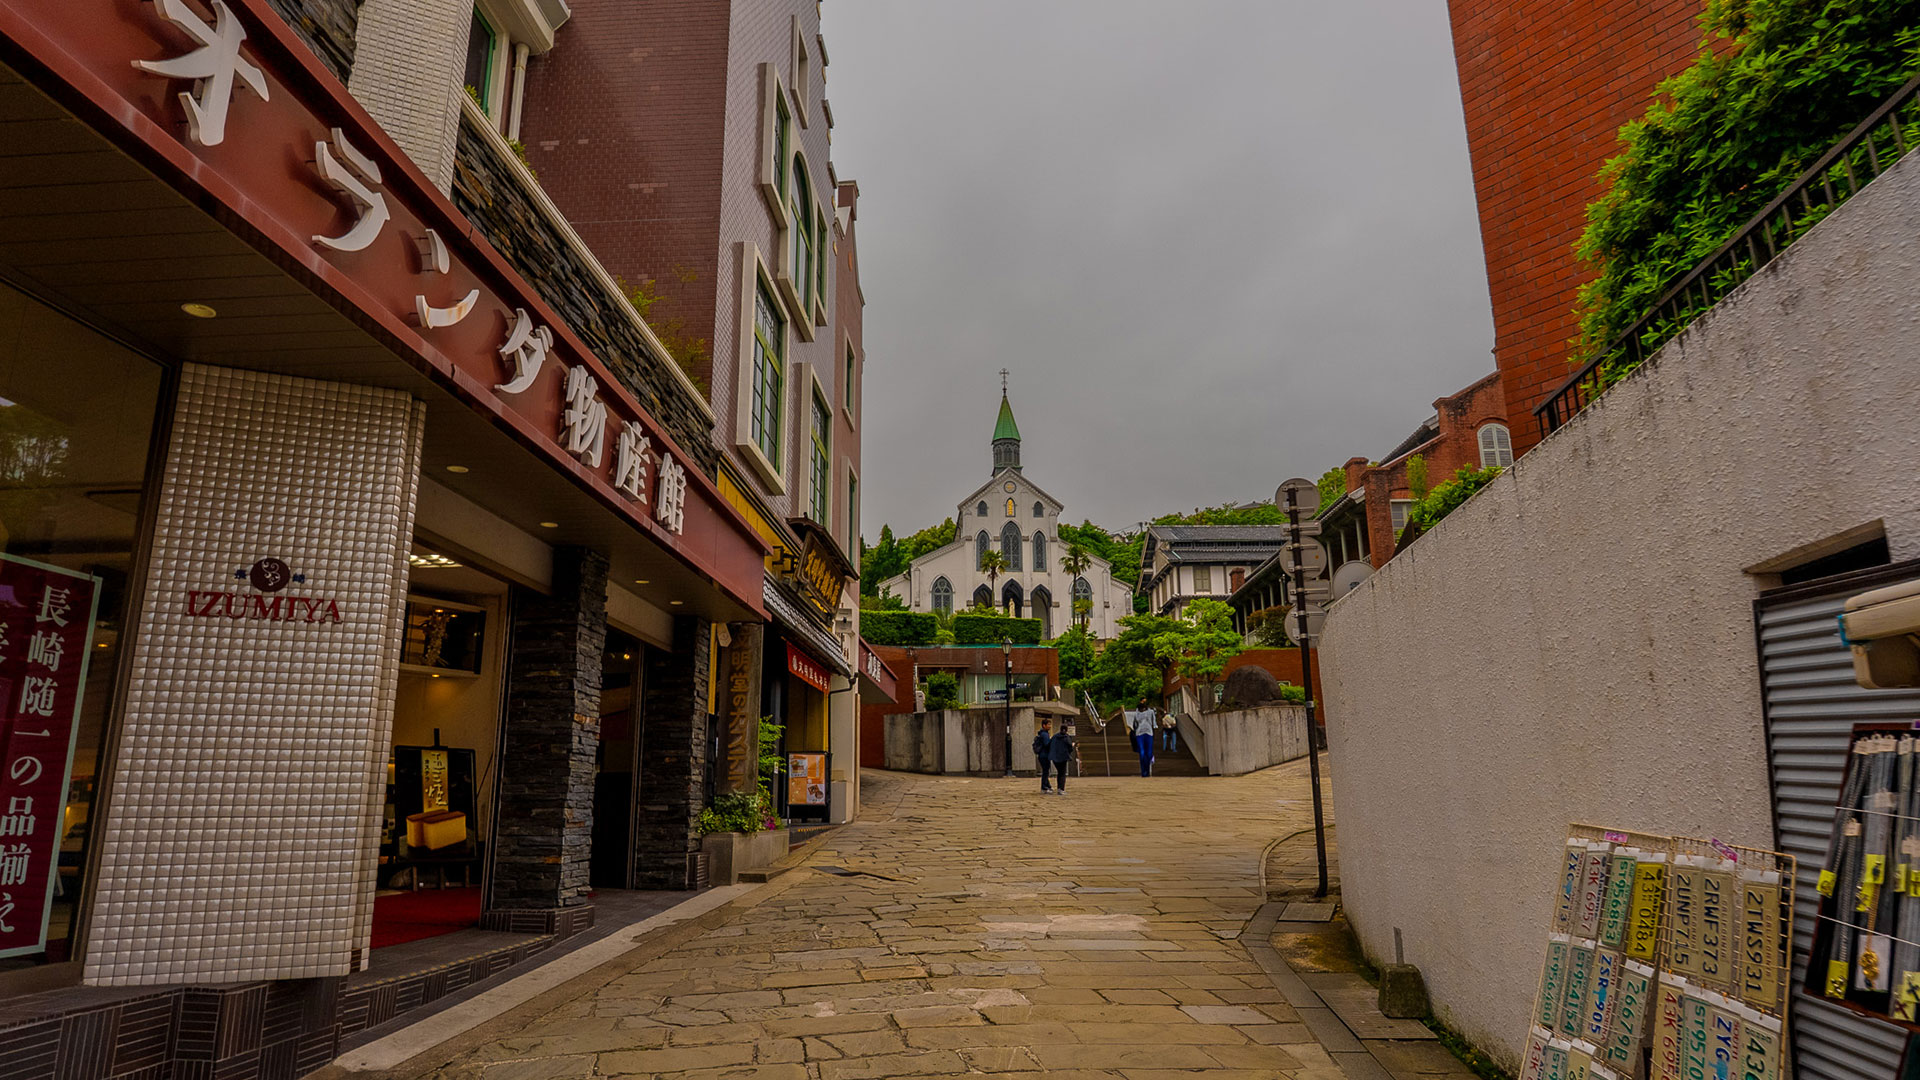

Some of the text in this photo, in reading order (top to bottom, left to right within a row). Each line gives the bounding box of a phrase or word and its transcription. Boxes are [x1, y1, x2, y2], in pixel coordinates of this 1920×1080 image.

[131, 0, 686, 535] オランダ物産館
[185, 591, 343, 624] IZUMIYA
[1605, 860, 1628, 940] ST956853
[1674, 874, 1692, 965] 2UNP715
[1702, 878, 1720, 975] 2RWF373
[1598, 953, 1612, 989] ZSR
[1744, 891, 1764, 994] 2TWS931
[1614, 981, 1640, 1062] 26679B
[1663, 991, 1677, 1031] 43K
[1688, 1005, 1707, 1080] ST9570
[1714, 1015, 1733, 1062] ZYG
